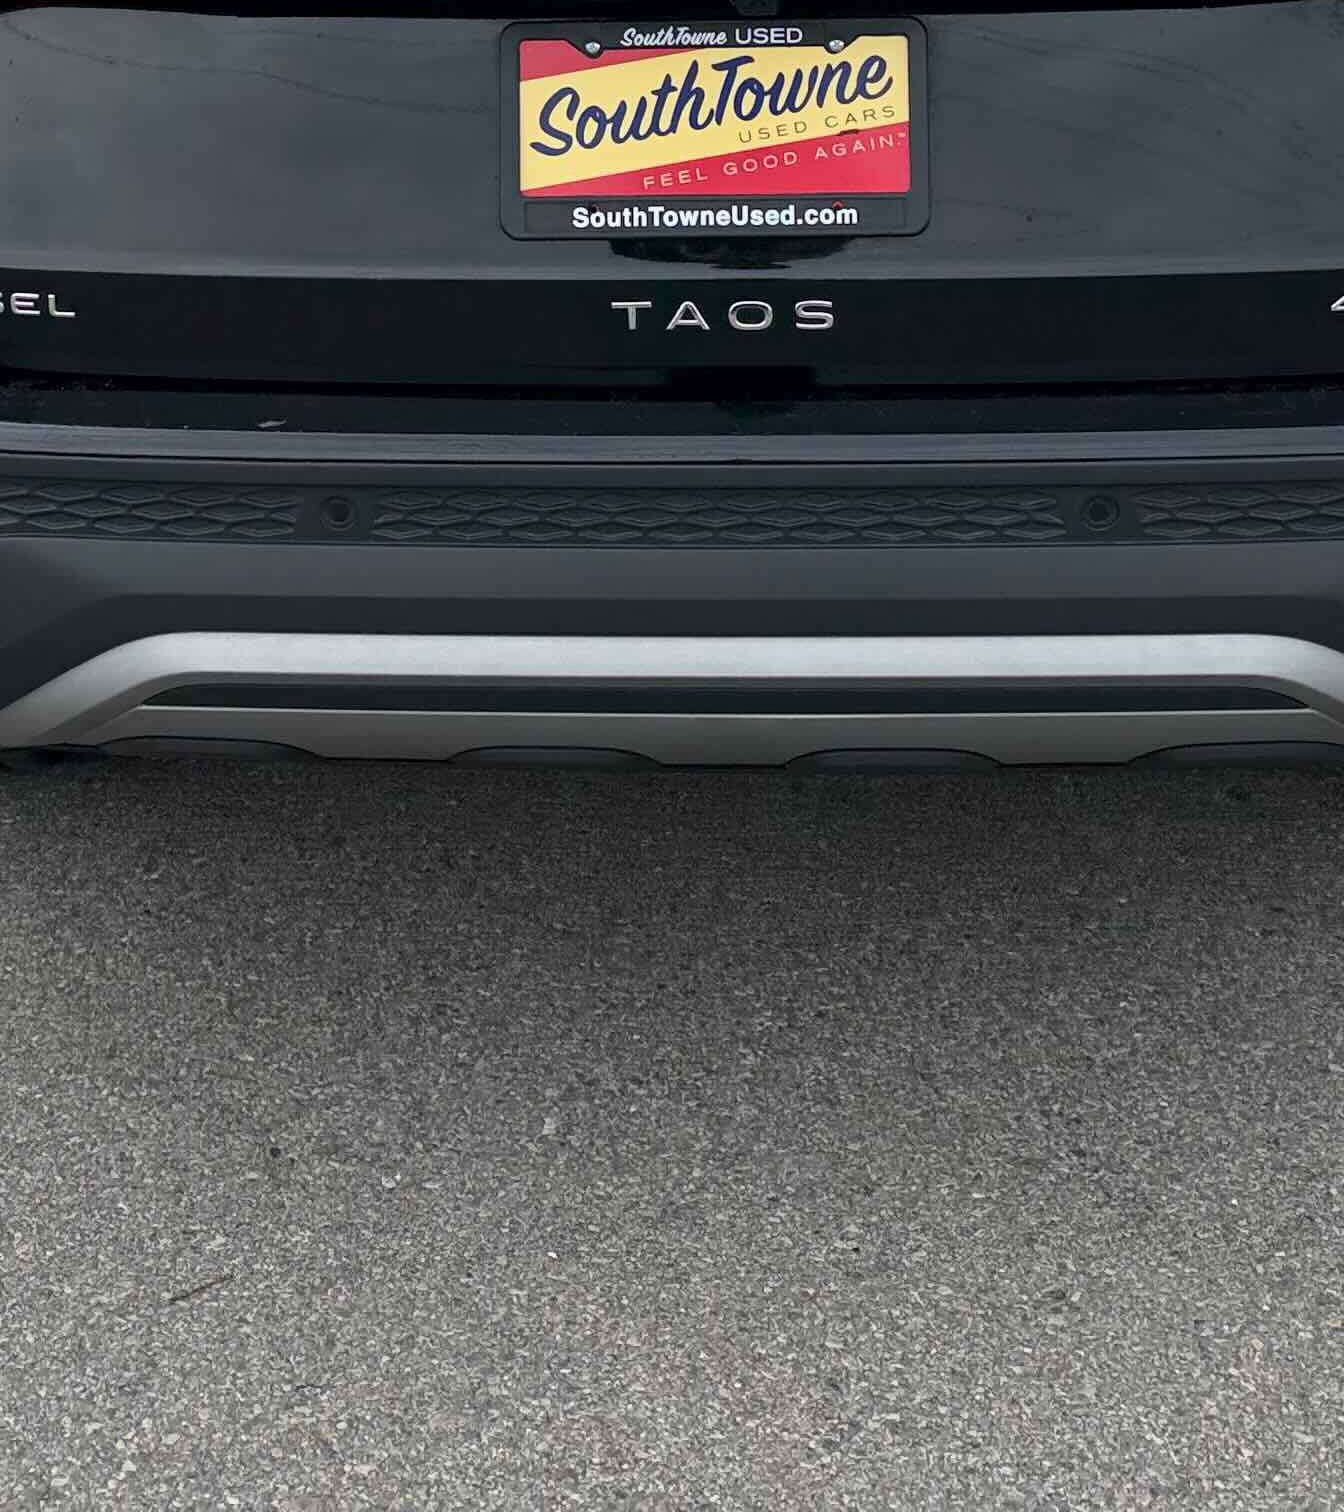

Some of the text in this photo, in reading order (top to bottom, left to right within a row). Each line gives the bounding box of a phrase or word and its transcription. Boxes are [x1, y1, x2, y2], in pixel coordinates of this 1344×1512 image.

[620, 26, 803, 47] SouthTowne USED
[529, 54, 893, 156] SouthTowne
[739, 106, 896, 143] USED CARS
[642, 168, 708, 190] FEEL
[723, 152, 798, 175] GOOD
[572, 205, 858, 229] SouthTowneUsed.com
[611, 300, 834, 331] TAOS
